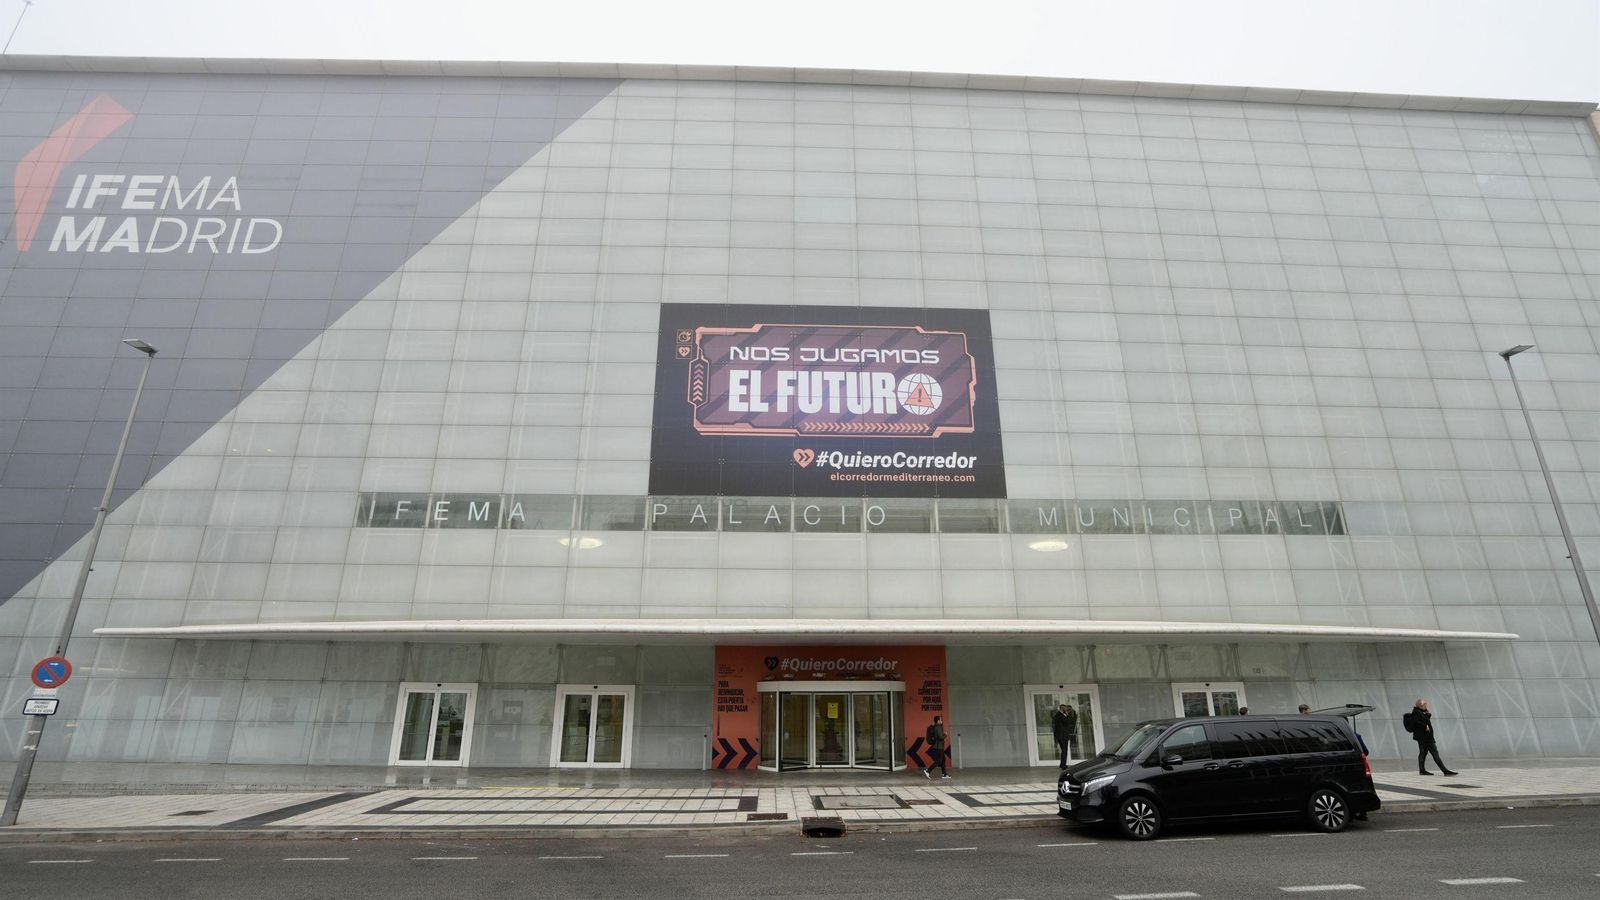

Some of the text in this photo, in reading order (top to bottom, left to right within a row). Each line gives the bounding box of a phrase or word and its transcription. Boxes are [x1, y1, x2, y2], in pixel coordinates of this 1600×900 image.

[65, 174, 241, 211] IFEMA
[48, 216, 283, 254] MADRID
[729, 346, 940, 364] NOS JUGAMOS
[728, 369, 769, 412] EL
[815, 450, 977, 470] #QuieroCorredor
[830, 472, 976, 483] elcorredormediterraneo.com
[652, 503, 886, 525] PALACIO
[1038, 506, 1313, 528] MUNICIPAL
[781, 657, 898, 672] #QuieroCorredor
